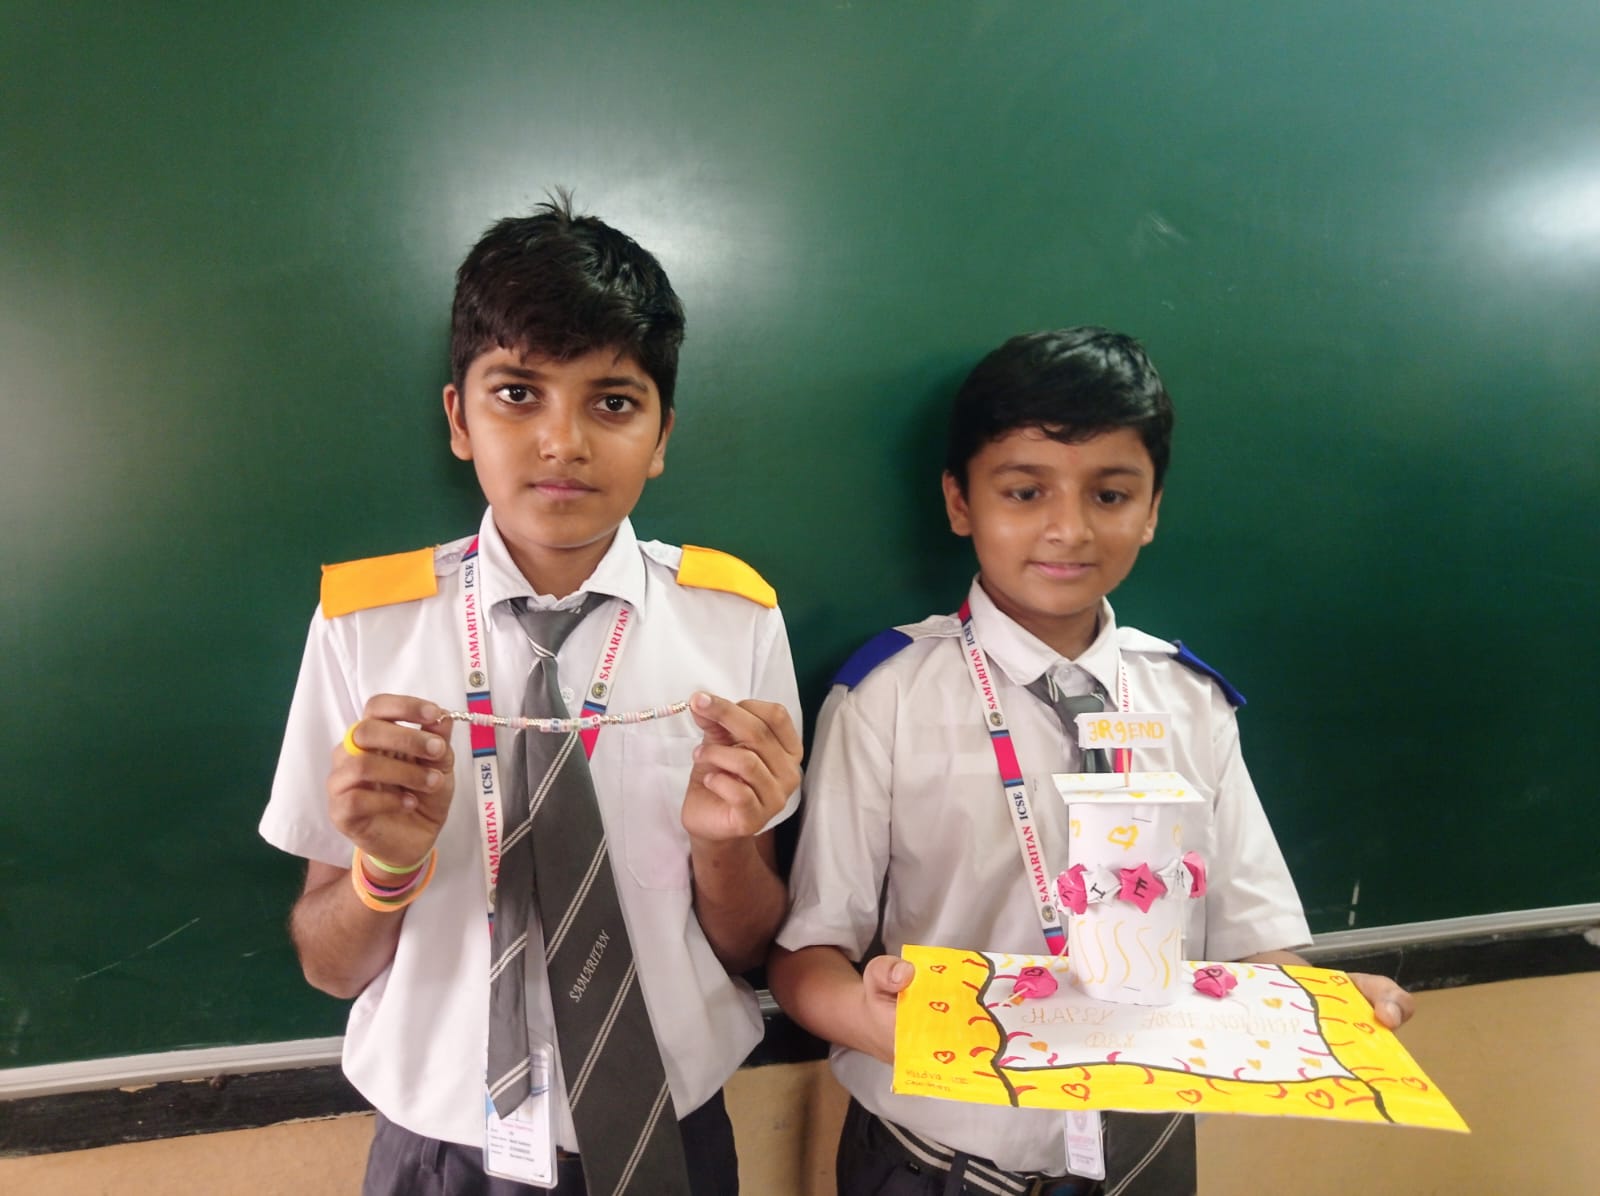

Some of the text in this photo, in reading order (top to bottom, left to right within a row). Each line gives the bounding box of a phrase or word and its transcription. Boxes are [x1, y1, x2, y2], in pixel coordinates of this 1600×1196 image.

[465, 562, 481, 668] SAMARITAN ICSE
[600, 609, 630, 680] SAMARITAN
[969, 648, 997, 710] SAMARITAN
[481, 763, 494, 795] ICSE
[1013, 792, 1050, 902] SAMARITAN ICSE
[569, 929, 611, 1003] SAMARITAN
